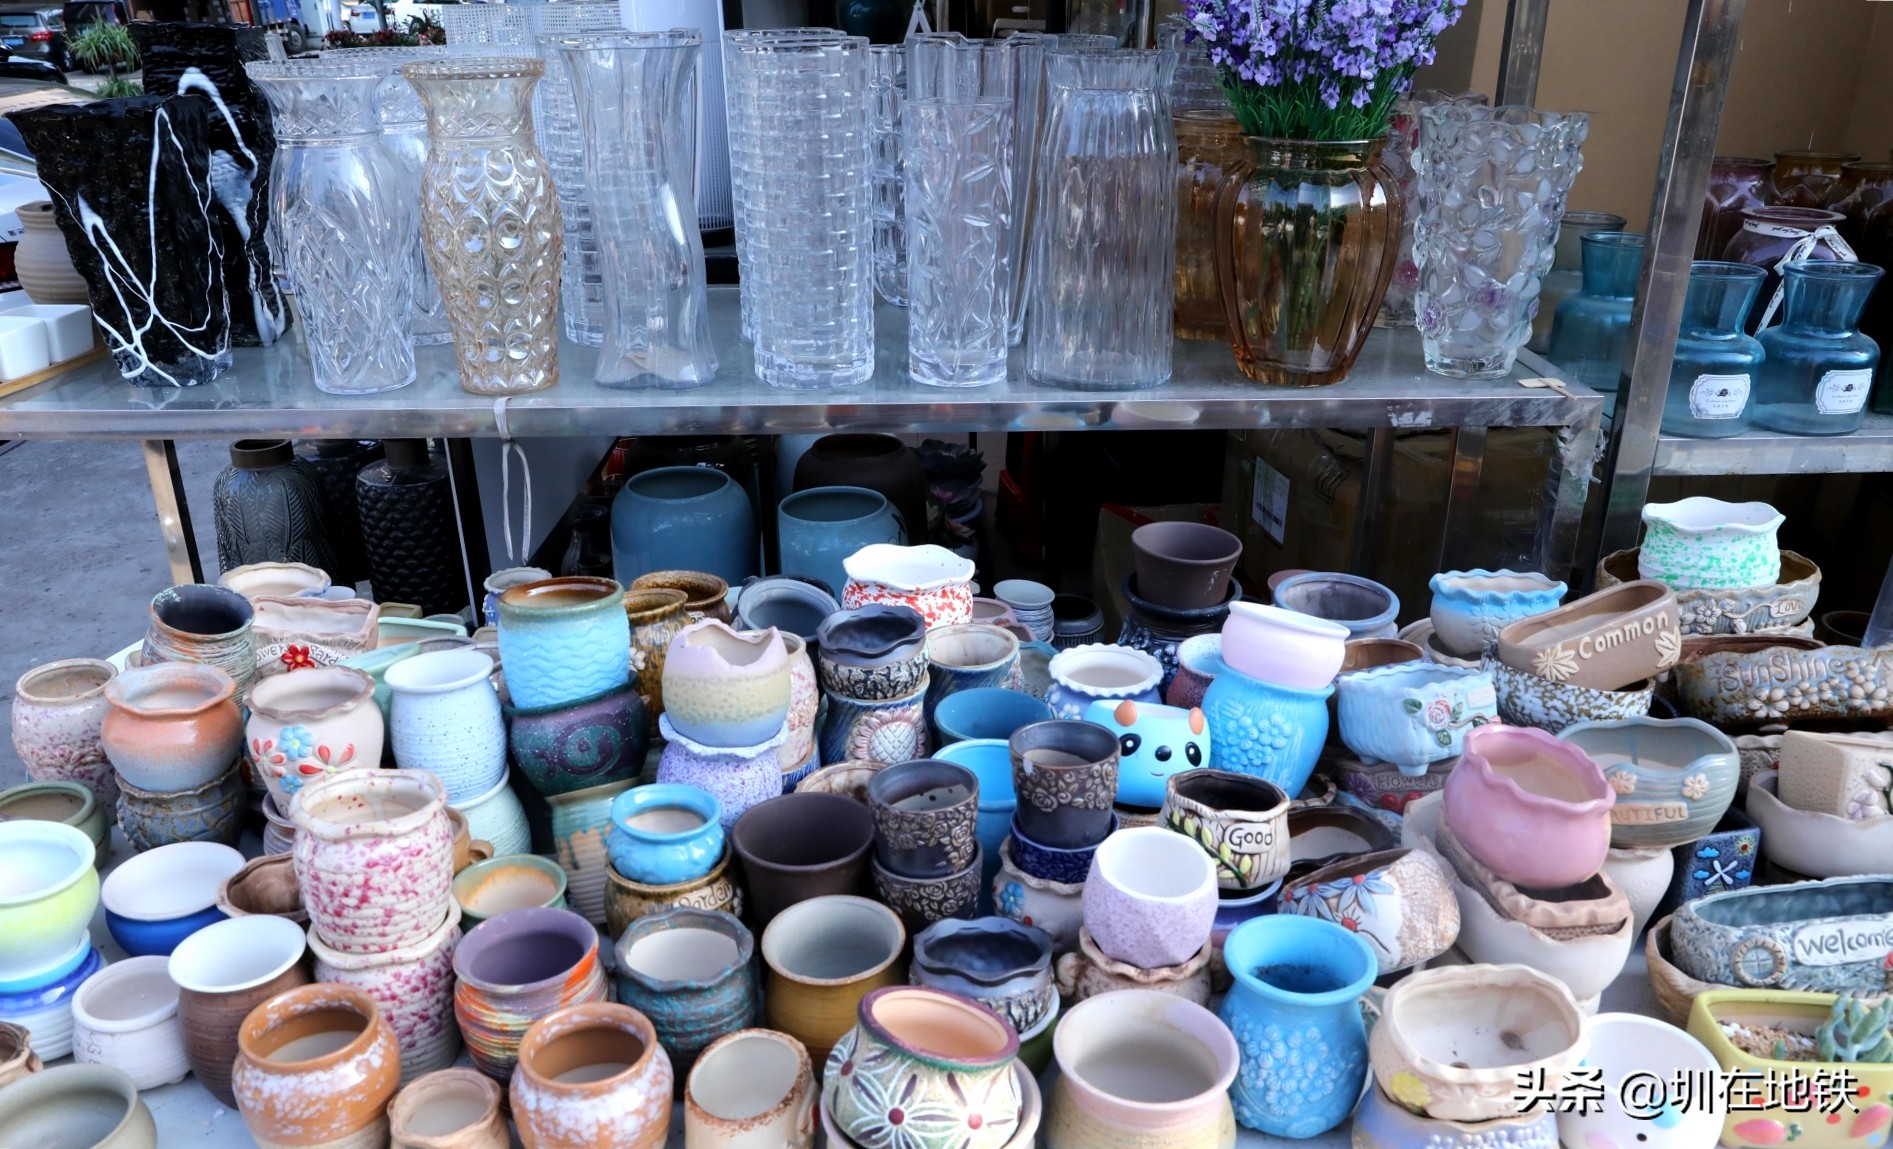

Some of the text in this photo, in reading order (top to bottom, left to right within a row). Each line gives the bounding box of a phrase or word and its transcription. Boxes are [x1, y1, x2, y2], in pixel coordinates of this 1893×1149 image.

[1775, 600, 1805, 615] Love
[1578, 611, 1669, 660] Common
[1611, 806, 1687, 822] AUTIFUL
[1228, 826, 1274, 851] Good
